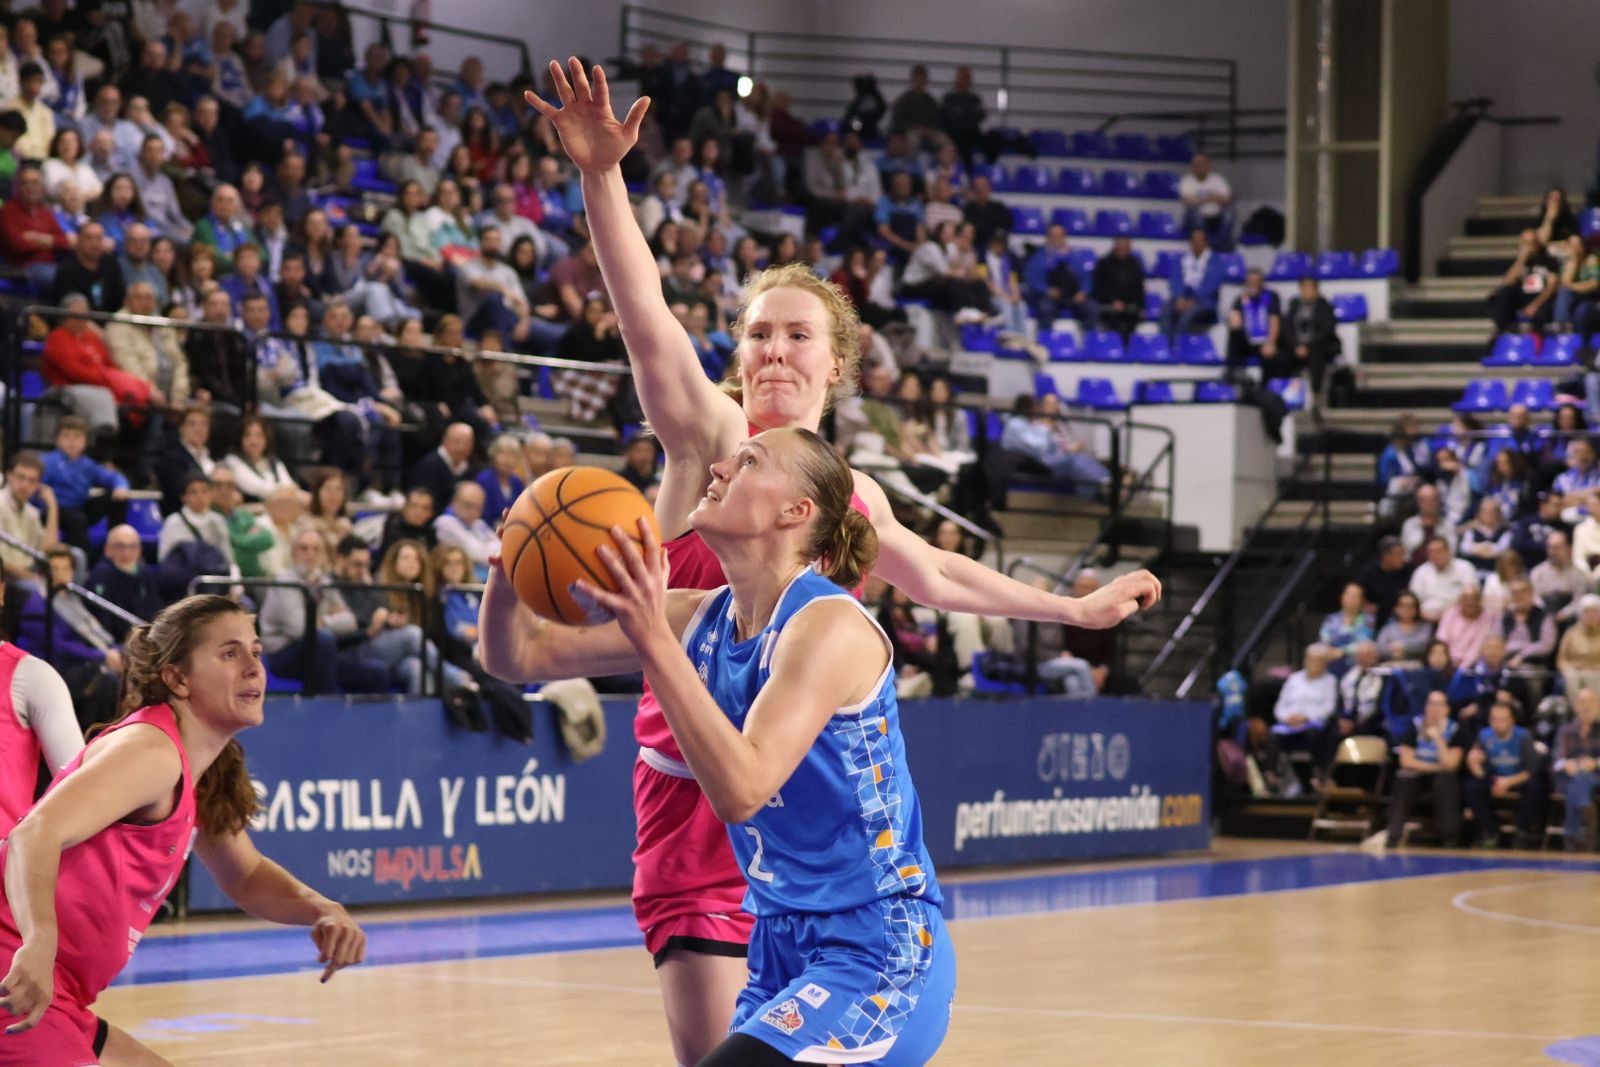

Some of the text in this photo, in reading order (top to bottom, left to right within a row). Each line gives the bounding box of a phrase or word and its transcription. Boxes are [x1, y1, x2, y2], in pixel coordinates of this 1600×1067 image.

[247, 757, 566, 838] CASTILLA Y LEÓN
[328, 842, 482, 891] NOS IMPULSA
[744, 826, 774, 883] 2
